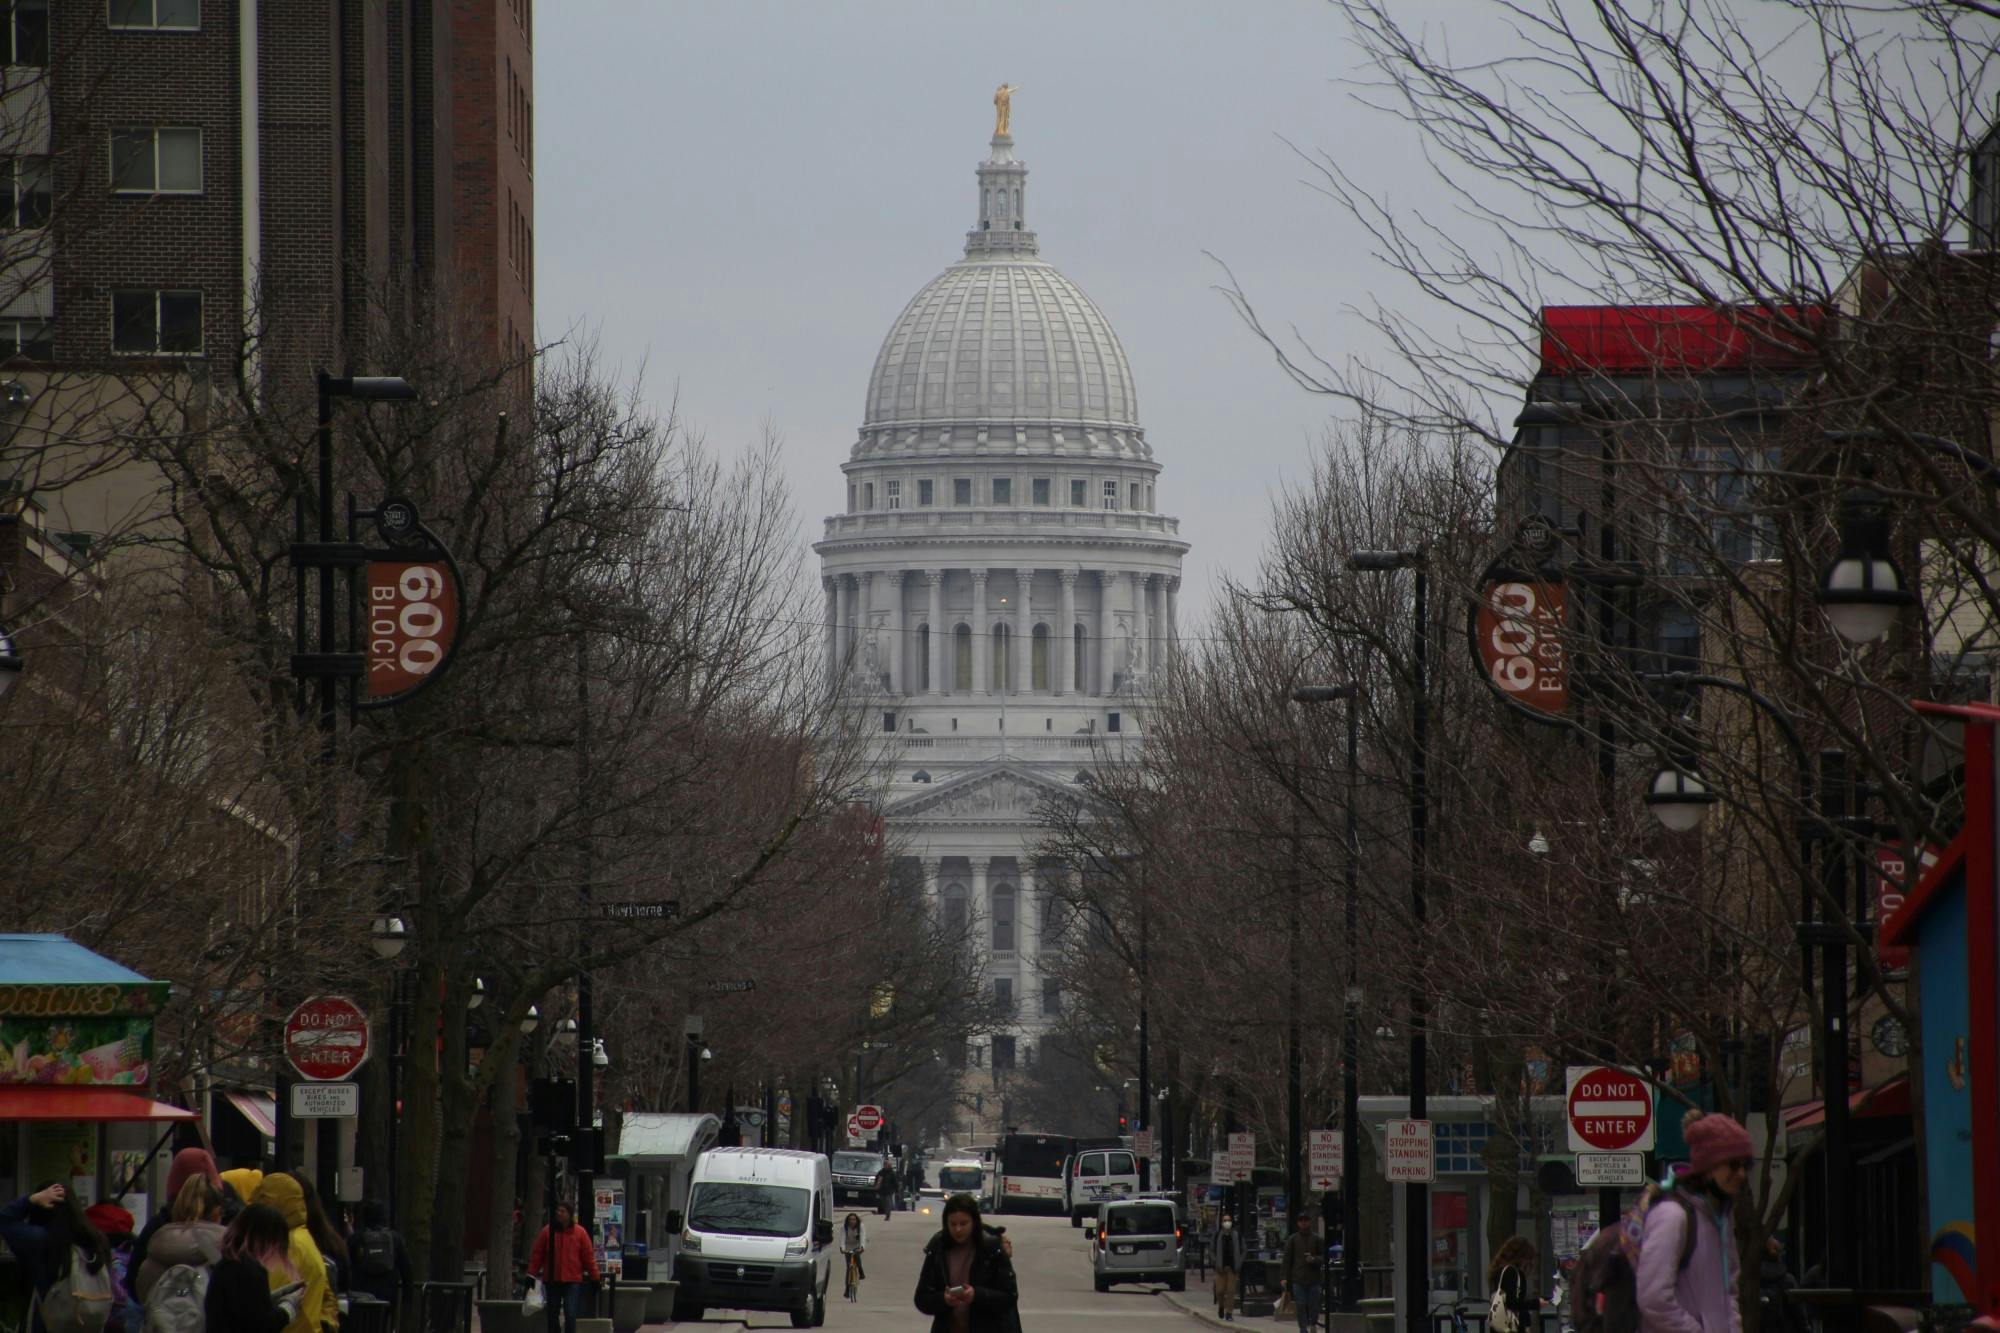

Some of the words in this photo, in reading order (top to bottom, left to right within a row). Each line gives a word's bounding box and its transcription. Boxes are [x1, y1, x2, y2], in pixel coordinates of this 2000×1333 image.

[399, 566, 443, 674] 600
[372, 586, 396, 671] BLOCK
[1491, 582, 1536, 692] 600
[300, 1013, 320, 1026] DO
[325, 1013, 354, 1026] NOT
[300, 1050, 352, 1063] ENTER
[1582, 1084, 1602, 1097] DO
[1608, 1084, 1636, 1097] NOT
[1402, 1124, 1416, 1136] NO
[1584, 1120, 1637, 1134] ENTER
[1237, 1135, 1247, 1143] NO
[1321, 1134, 1332, 1143] NO
[1390, 1138, 1428, 1147] STOPPING
[1312, 1143, 1341, 1151] STOPPING
[1390, 1149, 1429, 1158] STANDING
[1392, 1166, 1426, 1175] PARKING
